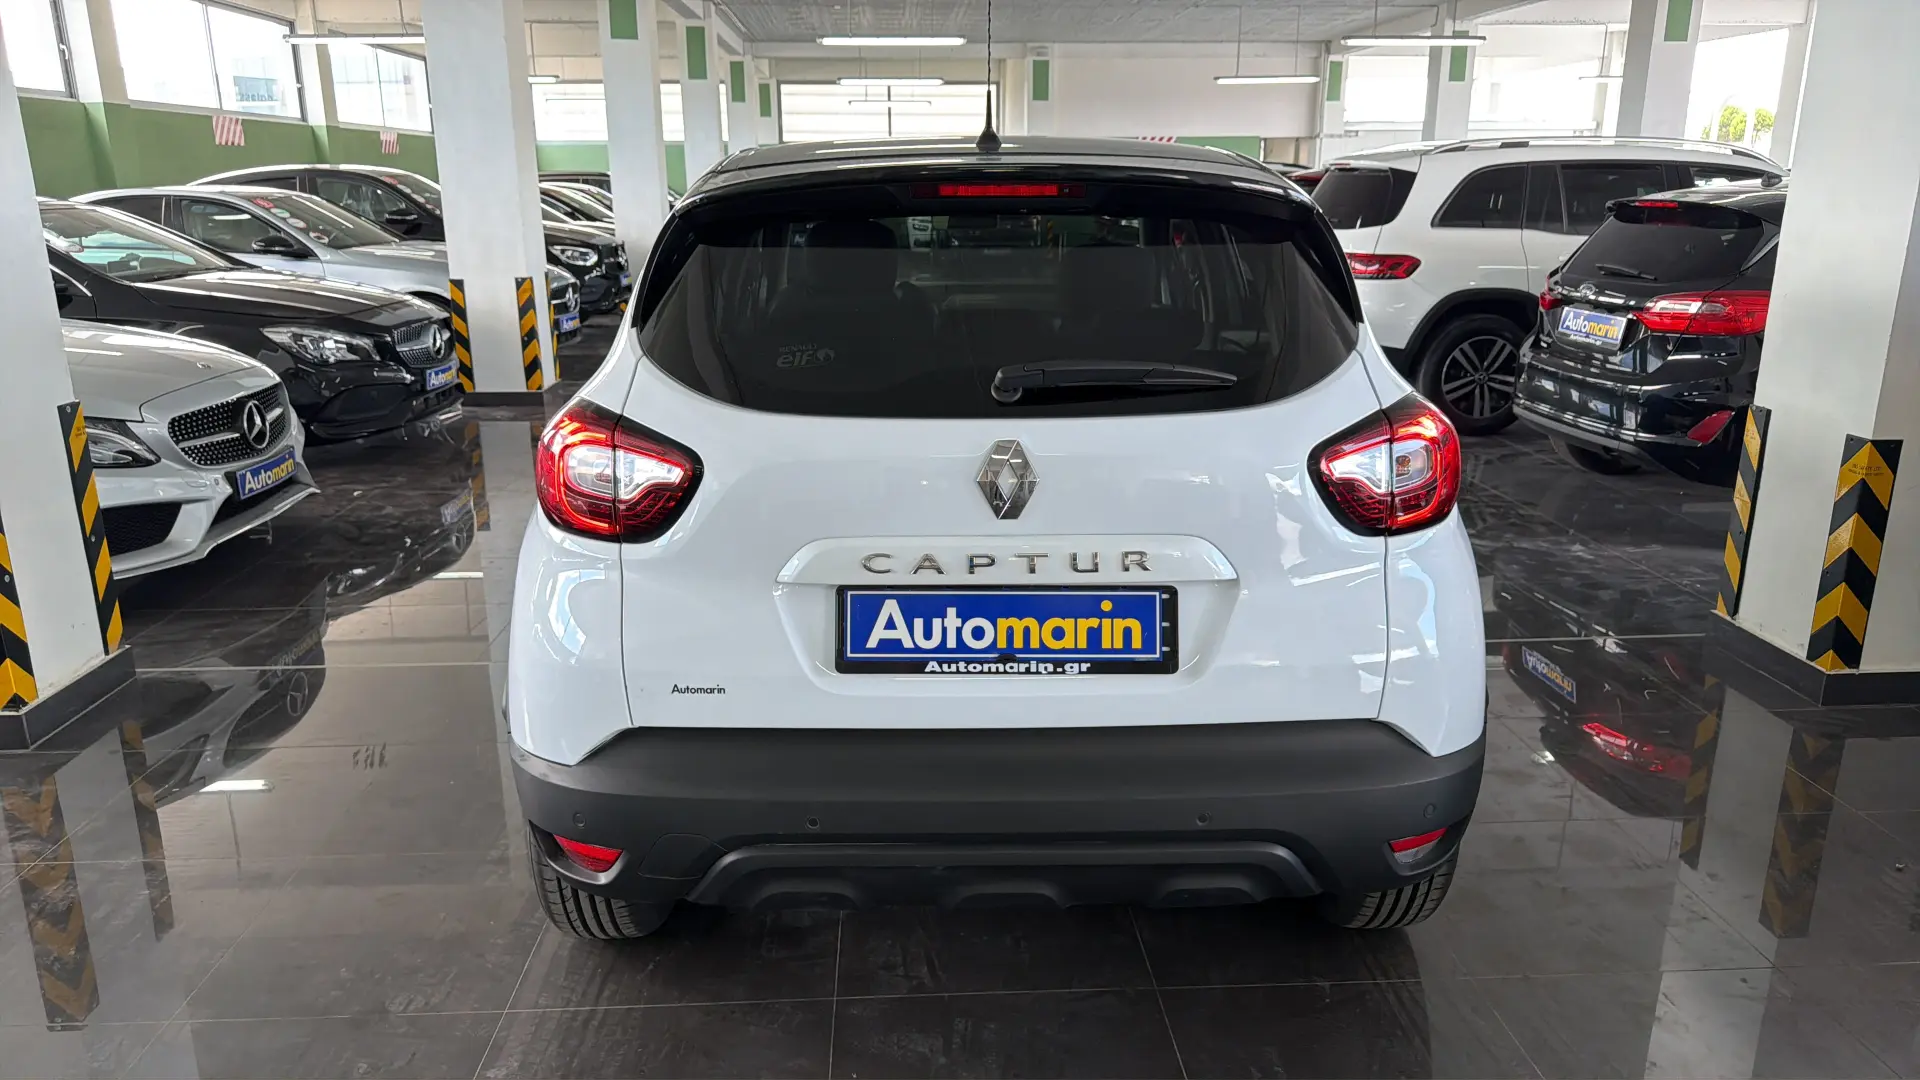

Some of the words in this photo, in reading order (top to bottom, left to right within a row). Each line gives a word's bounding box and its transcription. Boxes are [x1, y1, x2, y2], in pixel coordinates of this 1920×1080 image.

[1563, 311, 1619, 339] Automarin
[245, 454, 295, 494] Automarin
[860, 550, 1152, 575] CAPTUR
[865, 598, 1142, 650] Automarin
[924, 660, 1091, 675] Automarin.gr
[671, 683, 726, 695] Automarin
